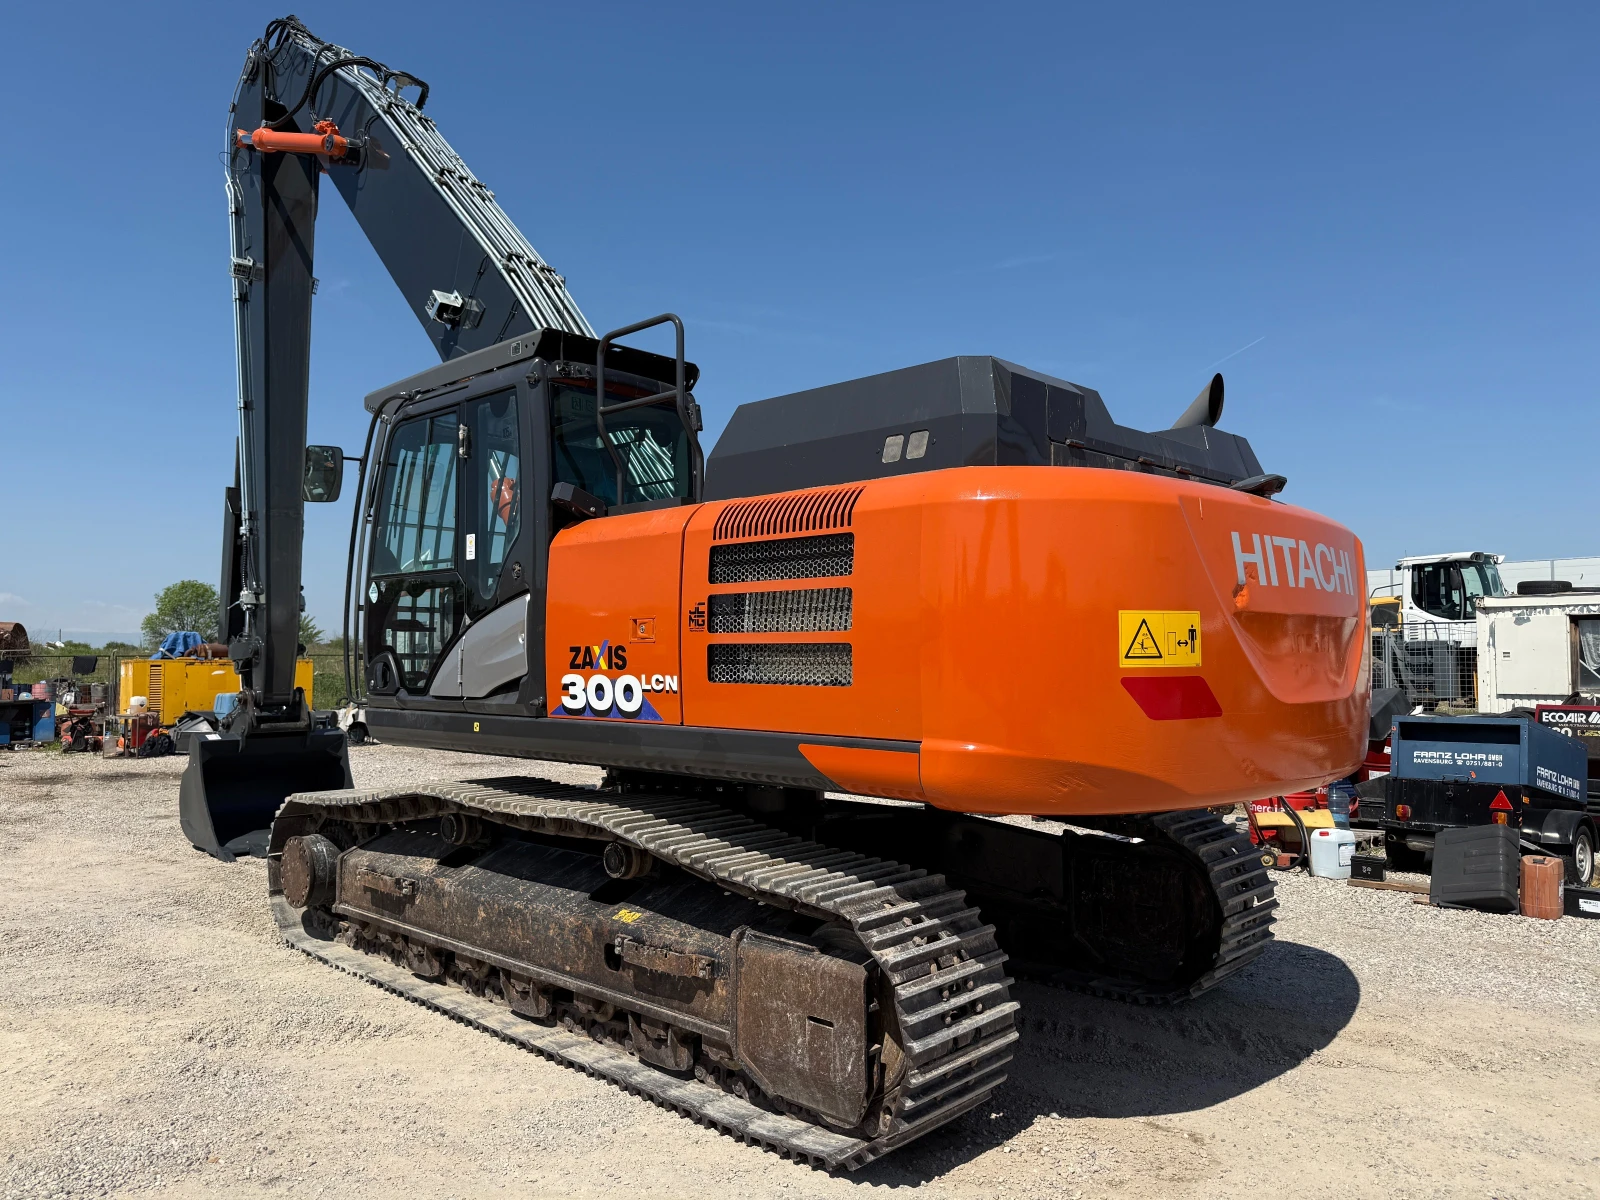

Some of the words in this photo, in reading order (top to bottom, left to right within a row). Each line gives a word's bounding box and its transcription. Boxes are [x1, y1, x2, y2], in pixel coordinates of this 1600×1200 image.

[1231, 531, 1354, 596] HITACHI
[569, 639, 628, 671] ZAXIS
[1542, 711, 1587, 724] ECOAIR
[1413, 751, 1453, 759] FRANZ
